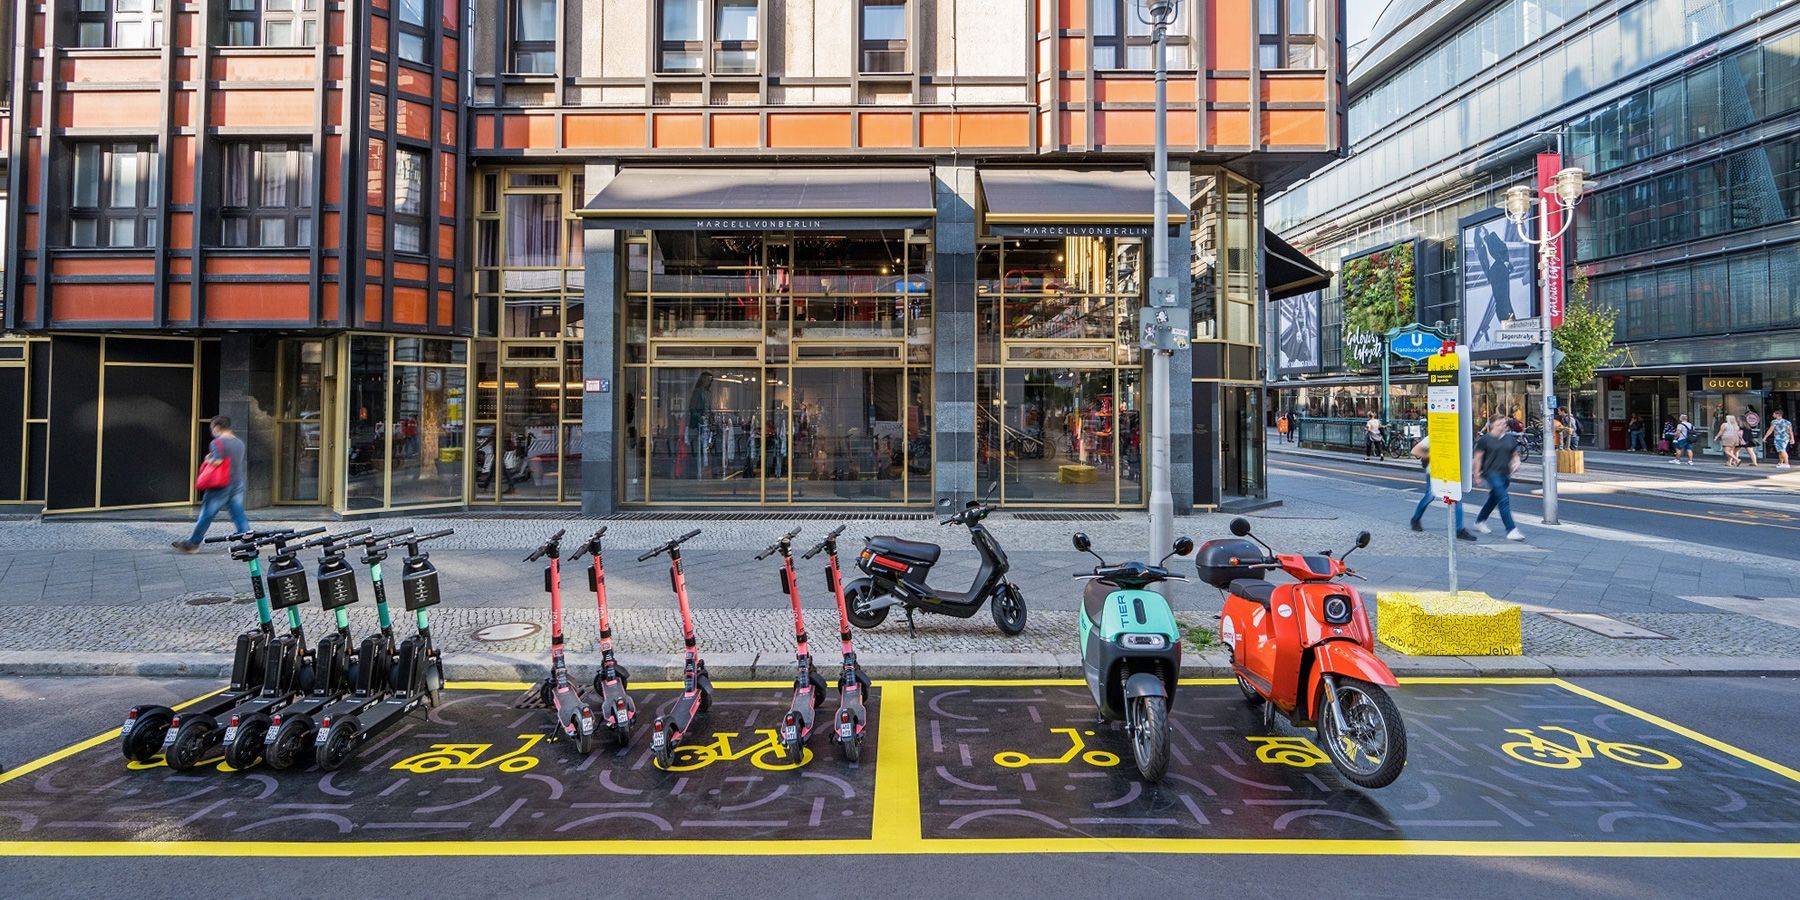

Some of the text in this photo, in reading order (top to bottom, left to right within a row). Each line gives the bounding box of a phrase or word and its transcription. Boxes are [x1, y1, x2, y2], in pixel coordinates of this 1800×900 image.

[1411, 333, 1423, 347] U
[1709, 380, 1749, 388] GUCCI
[1117, 594, 1130, 629] TIER
[1486, 645, 1514, 656] Jelbi
